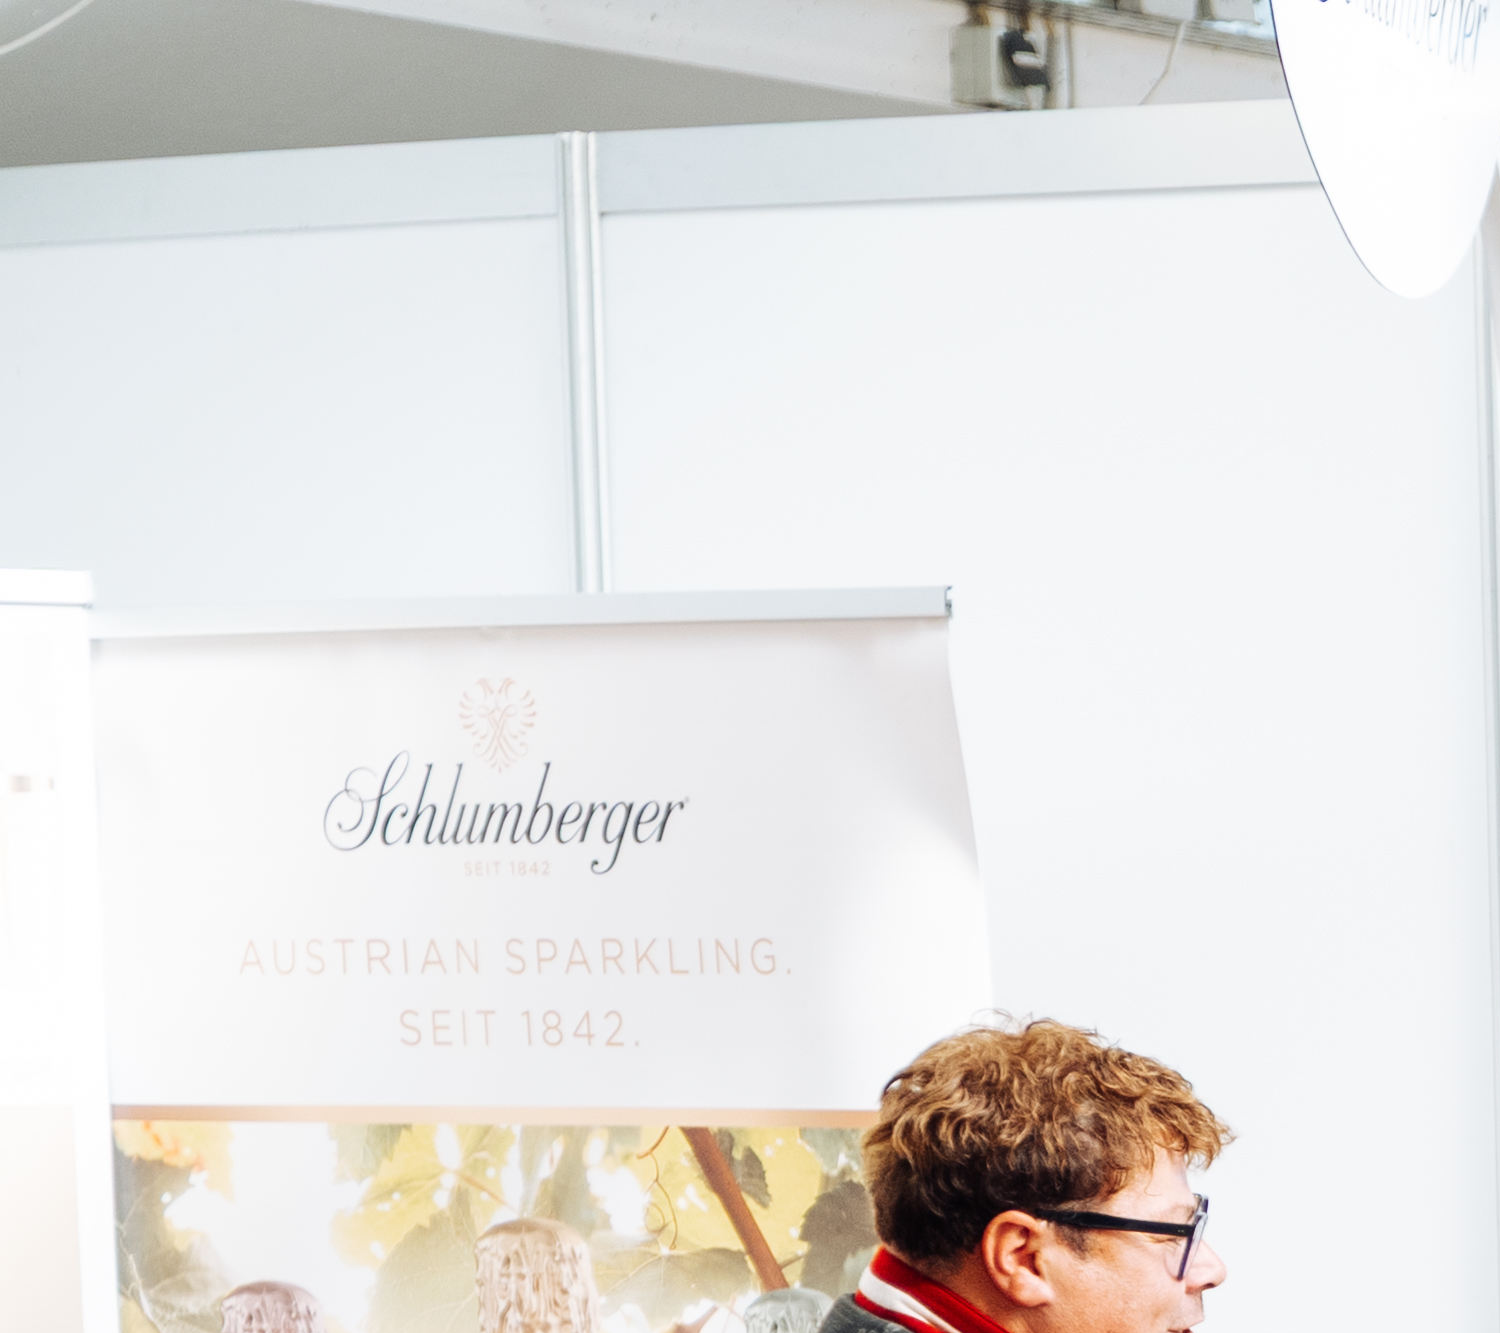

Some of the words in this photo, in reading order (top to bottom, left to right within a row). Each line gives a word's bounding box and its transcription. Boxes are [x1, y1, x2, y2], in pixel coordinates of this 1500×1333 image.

[323, 750, 688, 875] Schlumberger
[464, 860, 501, 877] SEIT
[509, 860, 552, 876] 1842
[238, 937, 480, 976] AUSTRIAN
[506, 937, 794, 976] SPARKLING.
[399, 1009, 496, 1047] SEIT
[522, 1009, 642, 1047] 1842.
